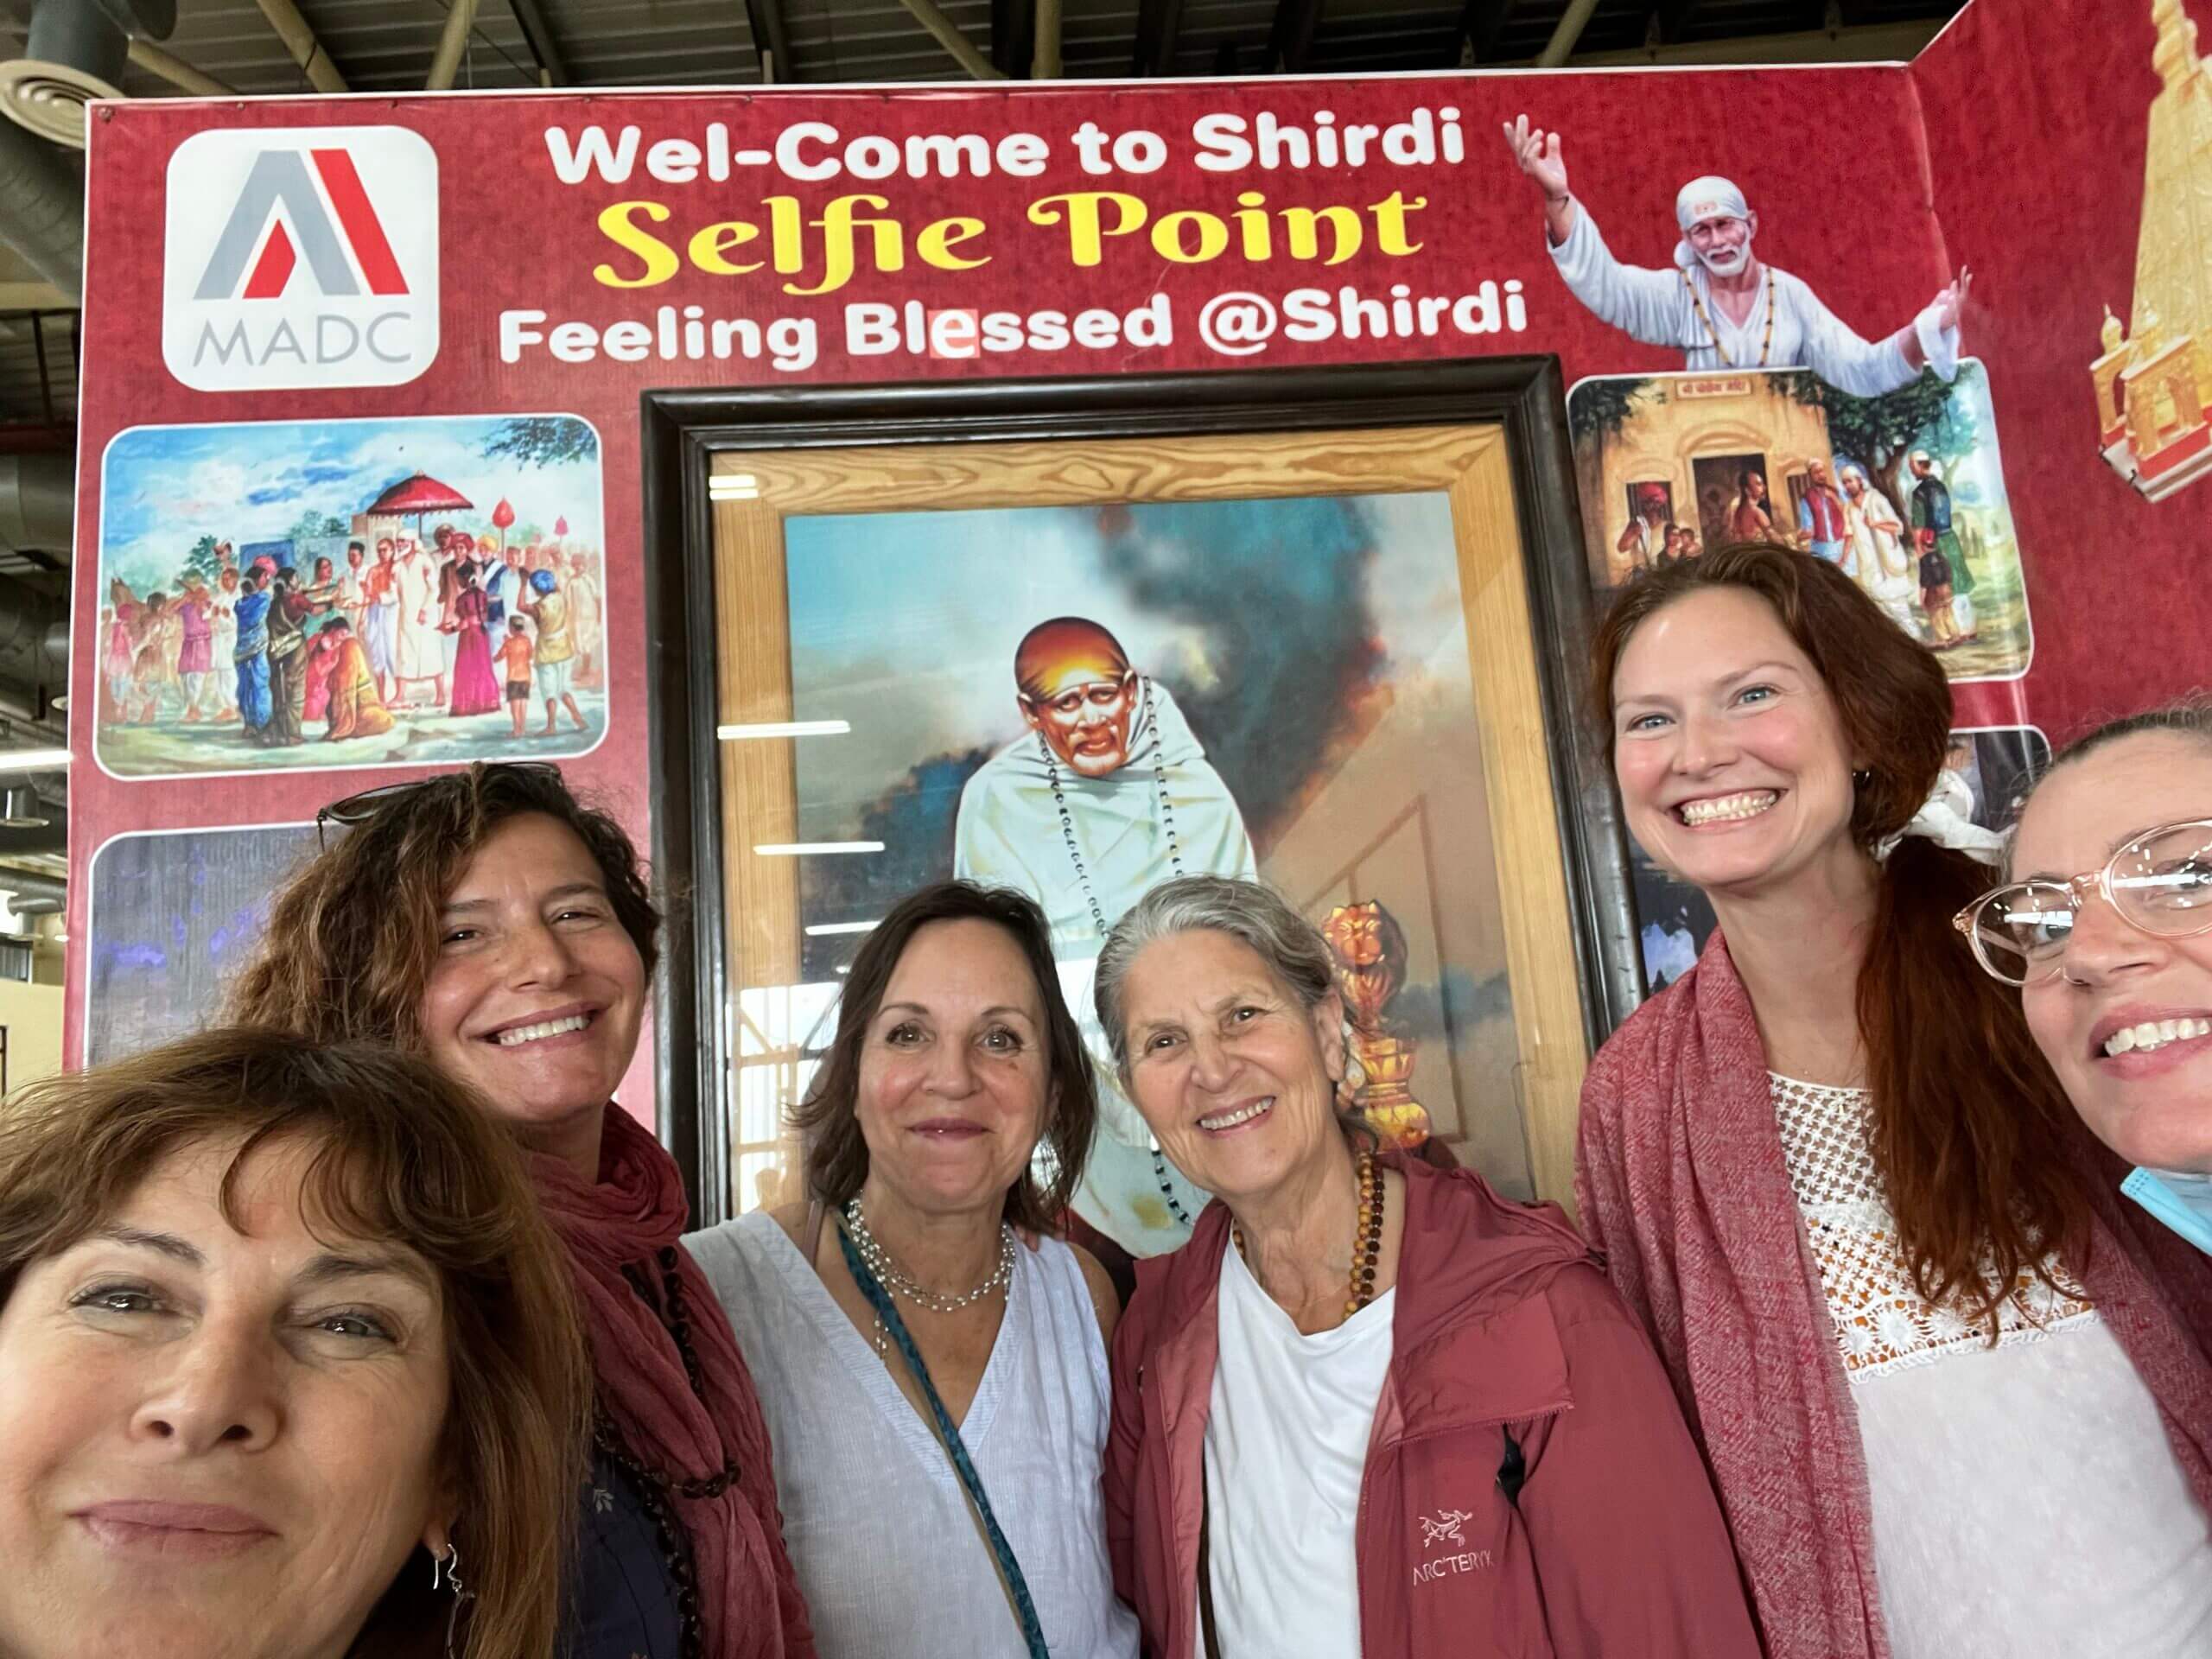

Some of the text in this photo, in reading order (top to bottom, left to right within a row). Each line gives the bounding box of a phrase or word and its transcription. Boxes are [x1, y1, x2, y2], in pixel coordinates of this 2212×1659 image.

[544, 106, 1465, 185] Wel-Come to Shirdi
[593, 191, 1428, 296] Selfie Point
[193, 312, 412, 367] MADC
[499, 279, 1527, 372] Feeling Blessed @Shirdi
